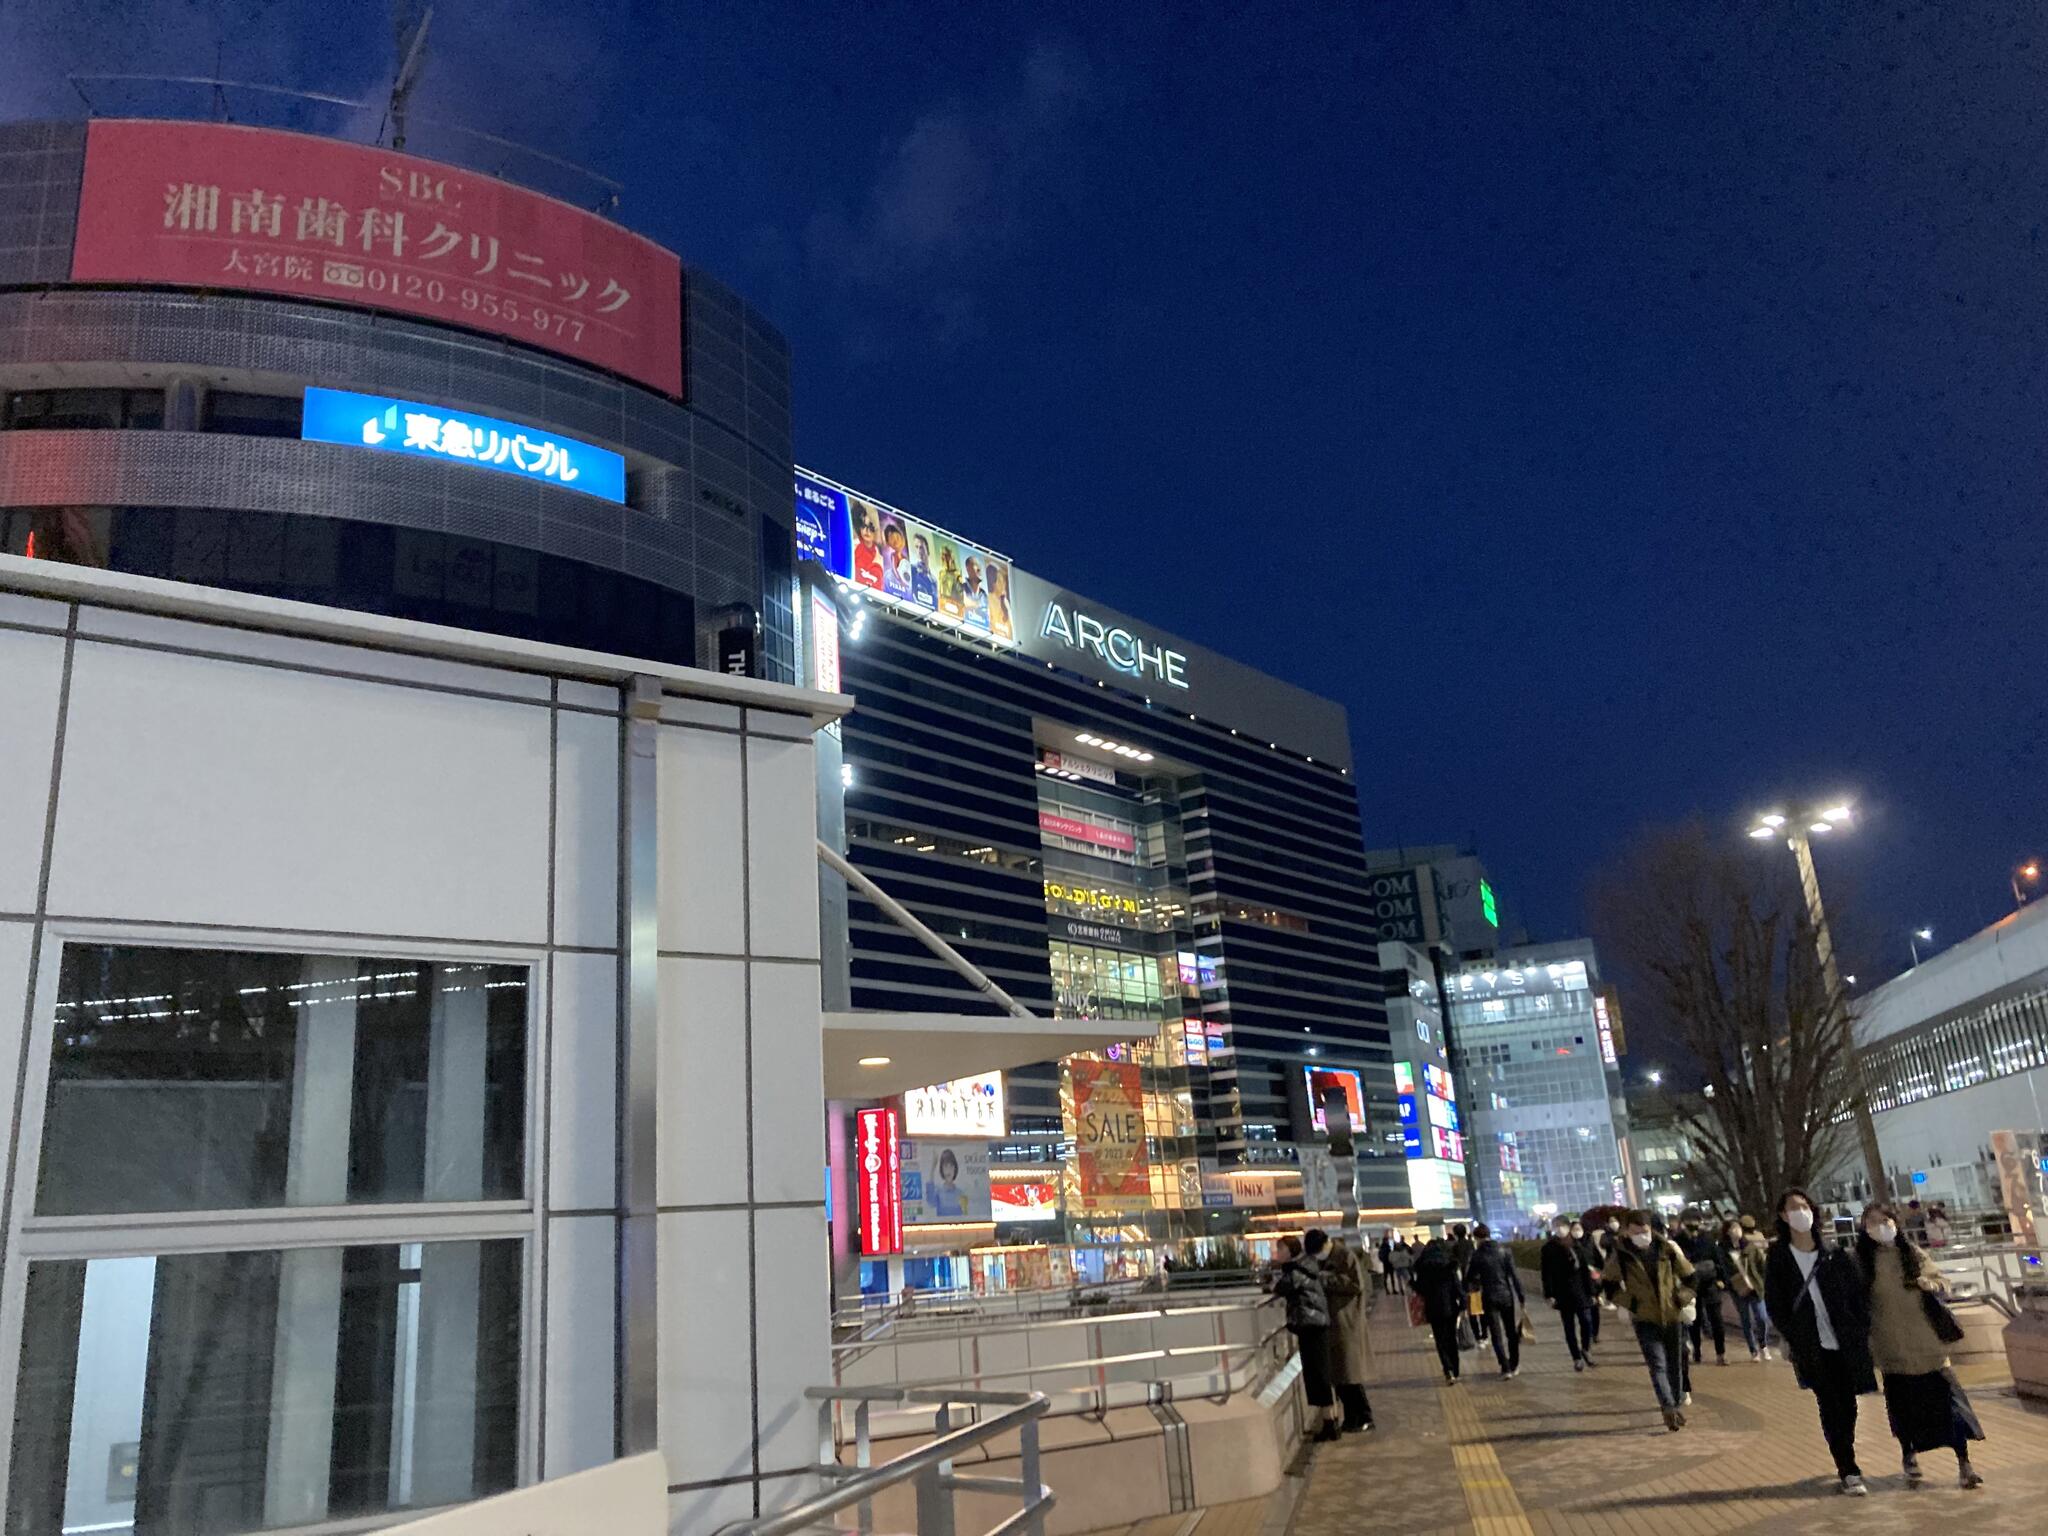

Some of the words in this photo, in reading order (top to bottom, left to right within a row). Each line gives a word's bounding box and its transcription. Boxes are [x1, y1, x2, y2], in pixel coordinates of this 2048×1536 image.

[379, 166, 463, 209] SBC
[163, 182, 631, 314] 湘南歯科クリニック
[222, 249, 315, 281] 大宮院
[367, 262, 587, 343] 0120-955-977
[404, 413, 579, 481] 東急リバブル
[1040, 600, 1189, 689] ARCHE
[1100, 894, 1136, 912] GYM
[1086, 1112, 1137, 1144] SALE
